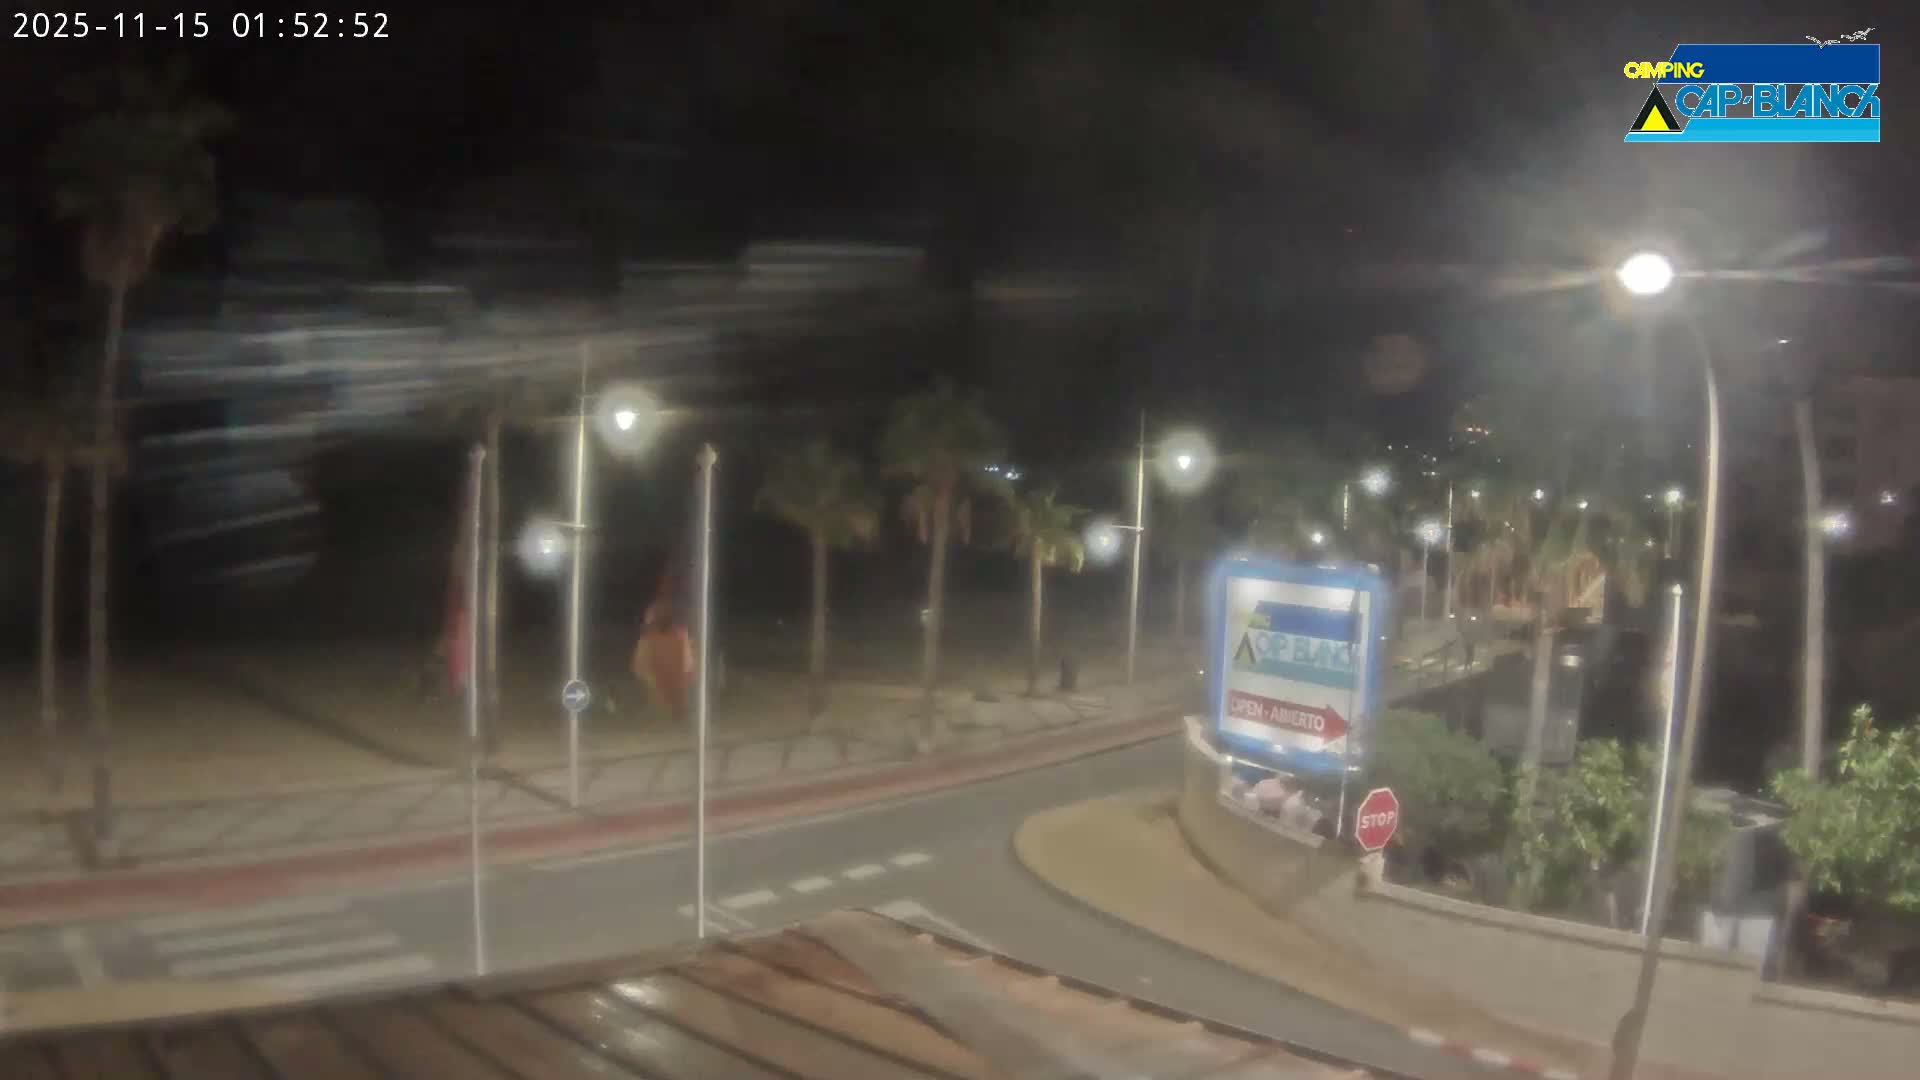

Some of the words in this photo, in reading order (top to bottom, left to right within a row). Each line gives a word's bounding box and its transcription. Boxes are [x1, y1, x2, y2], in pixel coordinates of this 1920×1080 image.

[1231, 697, 1263, 717] OPEN
[1270, 705, 1325, 732] ABIERTO
[1361, 811, 1395, 829] STOP
